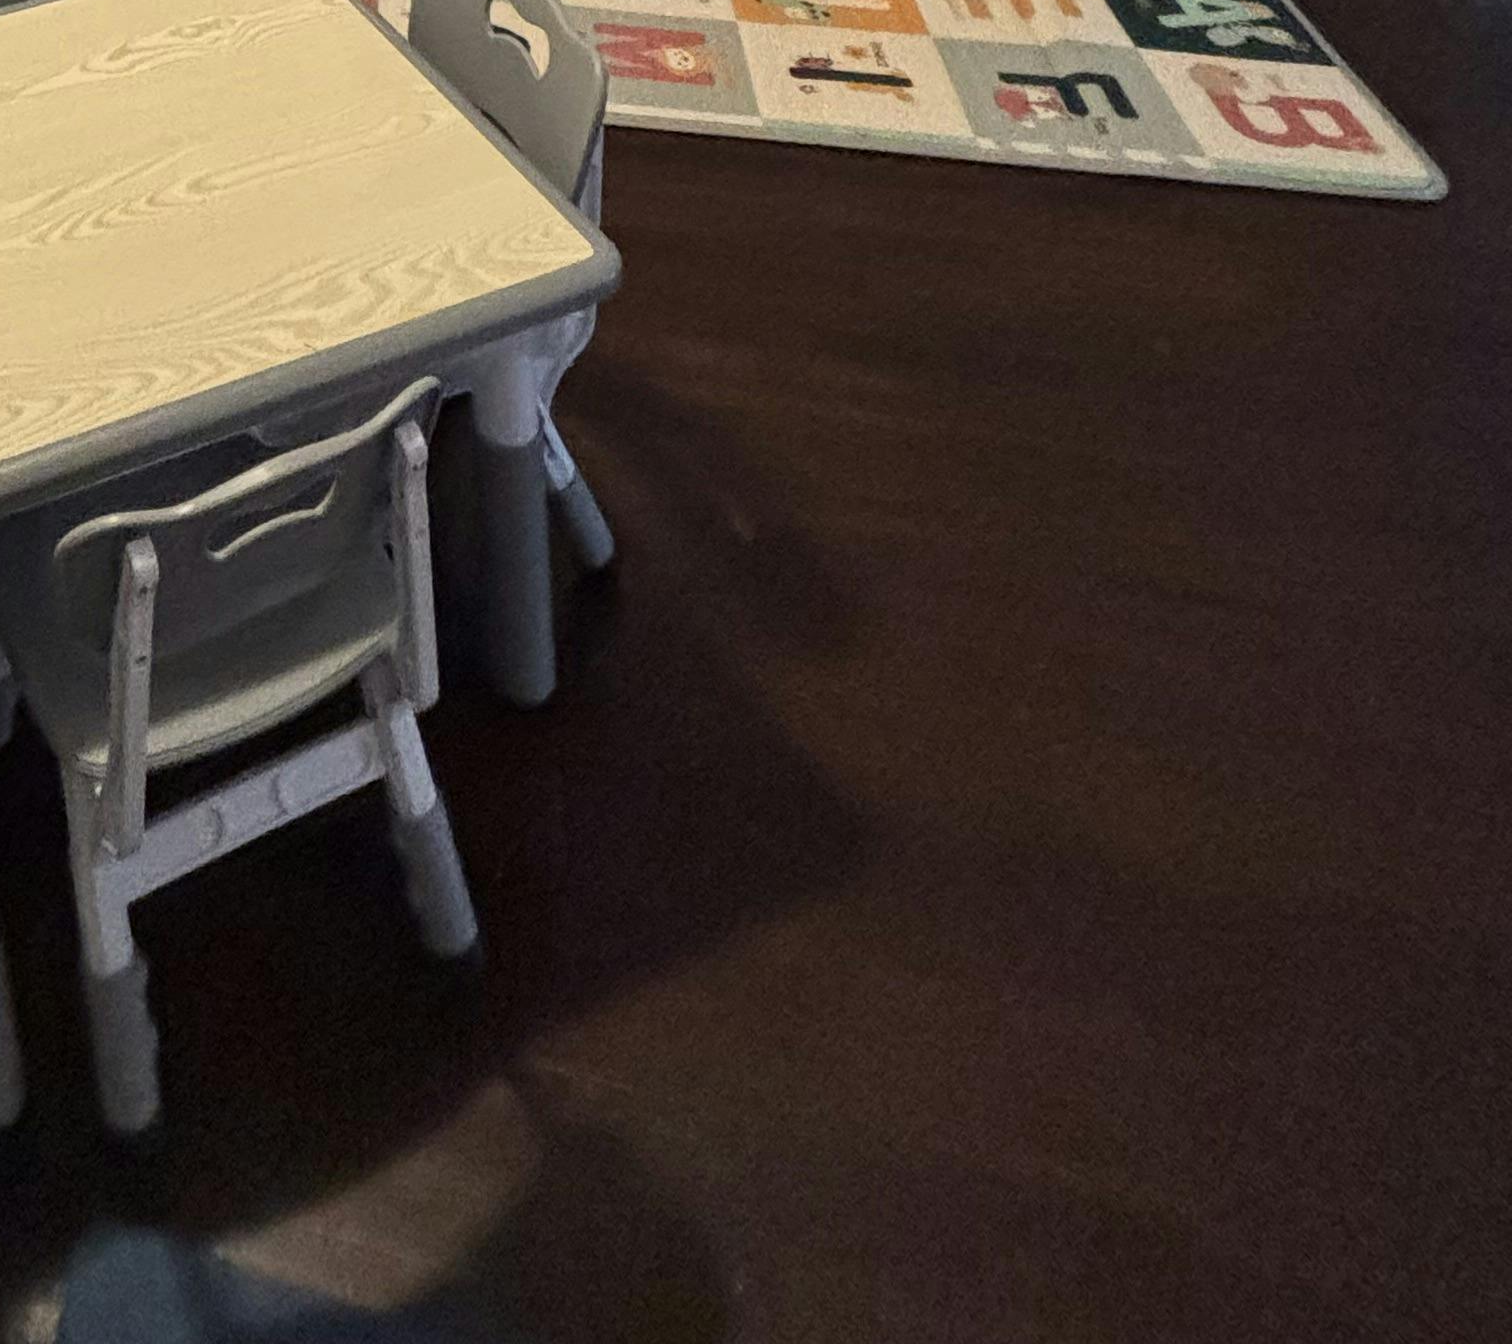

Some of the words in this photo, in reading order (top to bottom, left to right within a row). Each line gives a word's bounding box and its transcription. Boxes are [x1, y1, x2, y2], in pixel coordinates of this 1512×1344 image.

[594, 22, 715, 87] M
[789, 65, 914, 88] I
[998, 71, 1139, 119] F
[1202, 82, 1385, 154] B
